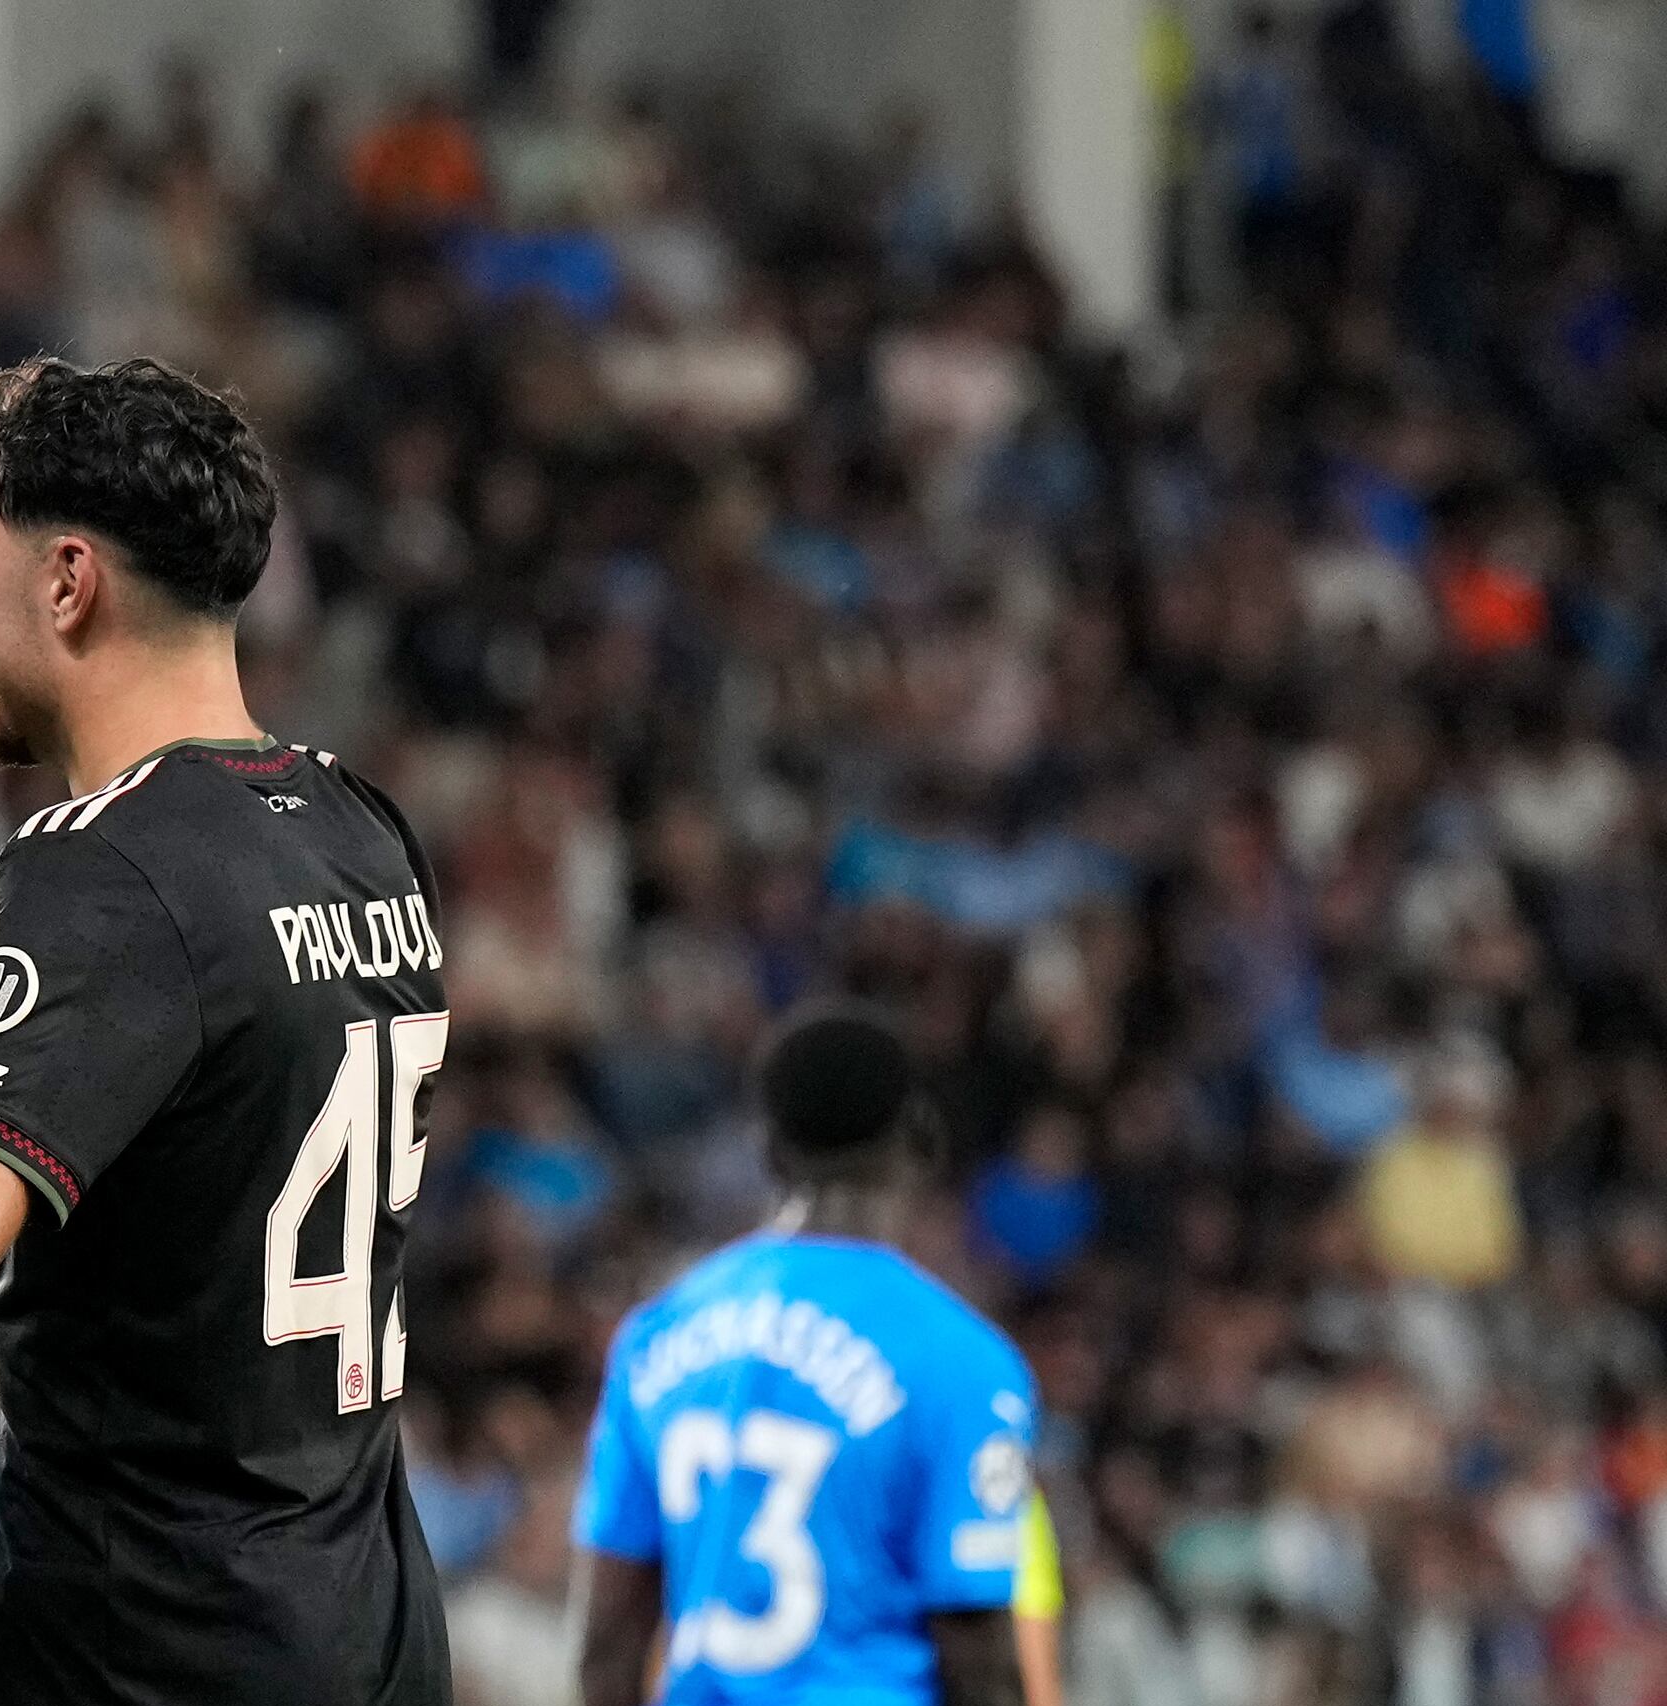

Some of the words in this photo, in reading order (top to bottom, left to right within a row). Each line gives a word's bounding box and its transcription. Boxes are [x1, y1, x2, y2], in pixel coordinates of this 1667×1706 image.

[259, 795, 308, 812] CBM
[269, 878, 443, 985] PAVLOVI
[264, 1009, 451, 1414] 45
